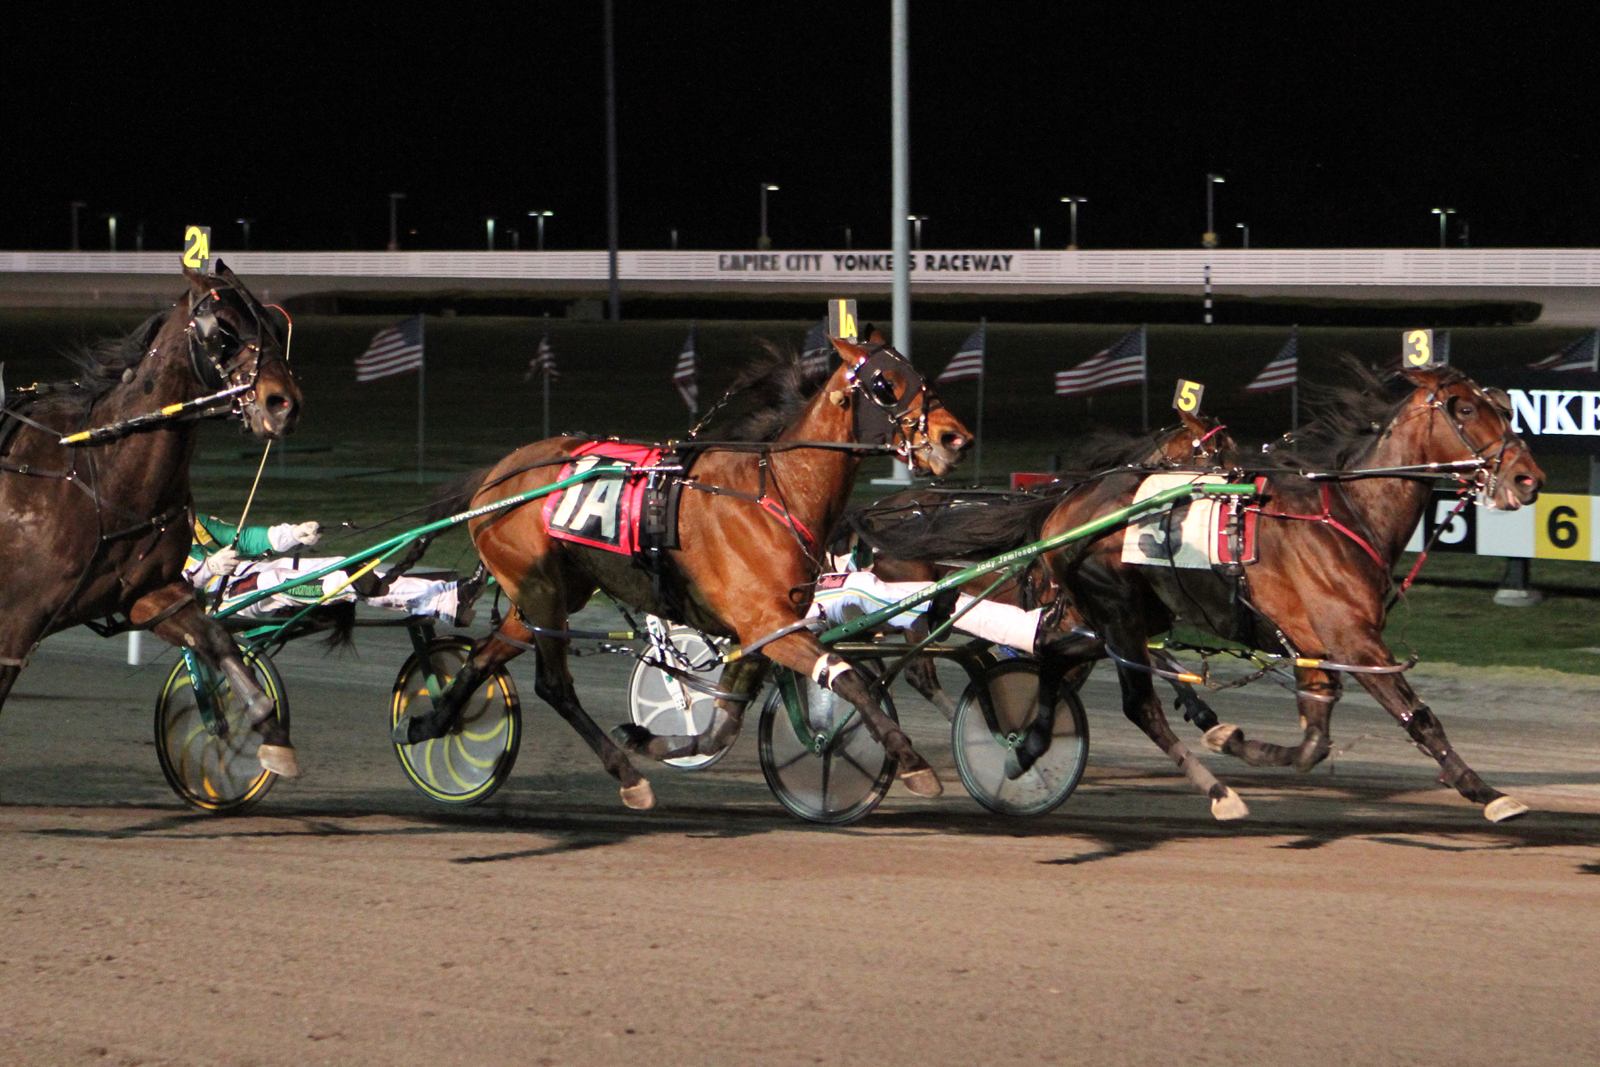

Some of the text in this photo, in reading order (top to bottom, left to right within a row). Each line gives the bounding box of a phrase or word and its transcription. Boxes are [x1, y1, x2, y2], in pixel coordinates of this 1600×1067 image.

[183, 226, 209, 268] 2A
[718, 254, 1014, 272] EMPIRE CITY YONKES RACEWAY
[1407, 330, 1430, 366] 3
[1177, 380, 1200, 412] 5
[551, 454, 632, 539] 1A
[1433, 499, 1579, 549] 5 6
[975, 546, 1037, 572] Jody Jamieson
